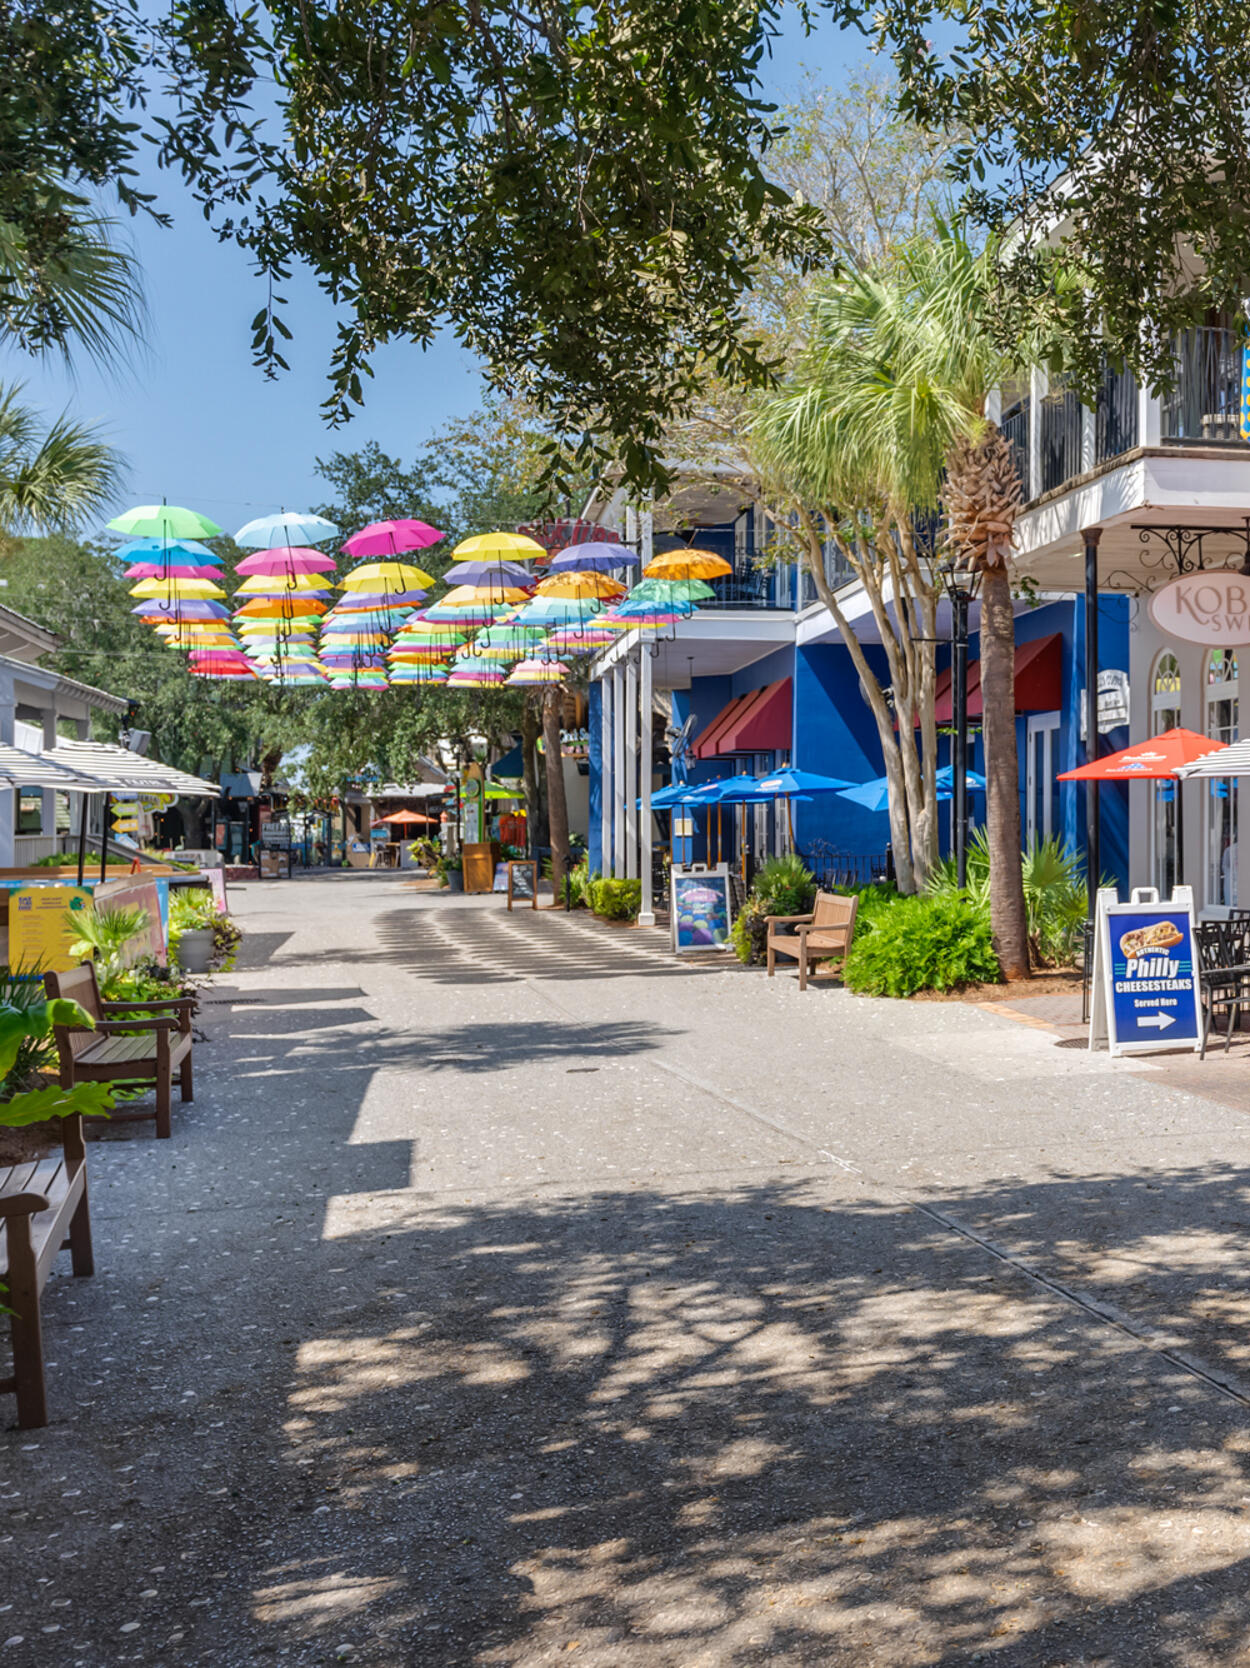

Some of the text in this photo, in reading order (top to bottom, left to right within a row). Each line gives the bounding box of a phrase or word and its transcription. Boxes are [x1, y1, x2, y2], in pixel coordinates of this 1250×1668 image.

[1125, 957, 1180, 979] Philly
[1115, 979, 1193, 993] CHEESESTEAKS
[1134, 997, 1178, 1008] Served Here
